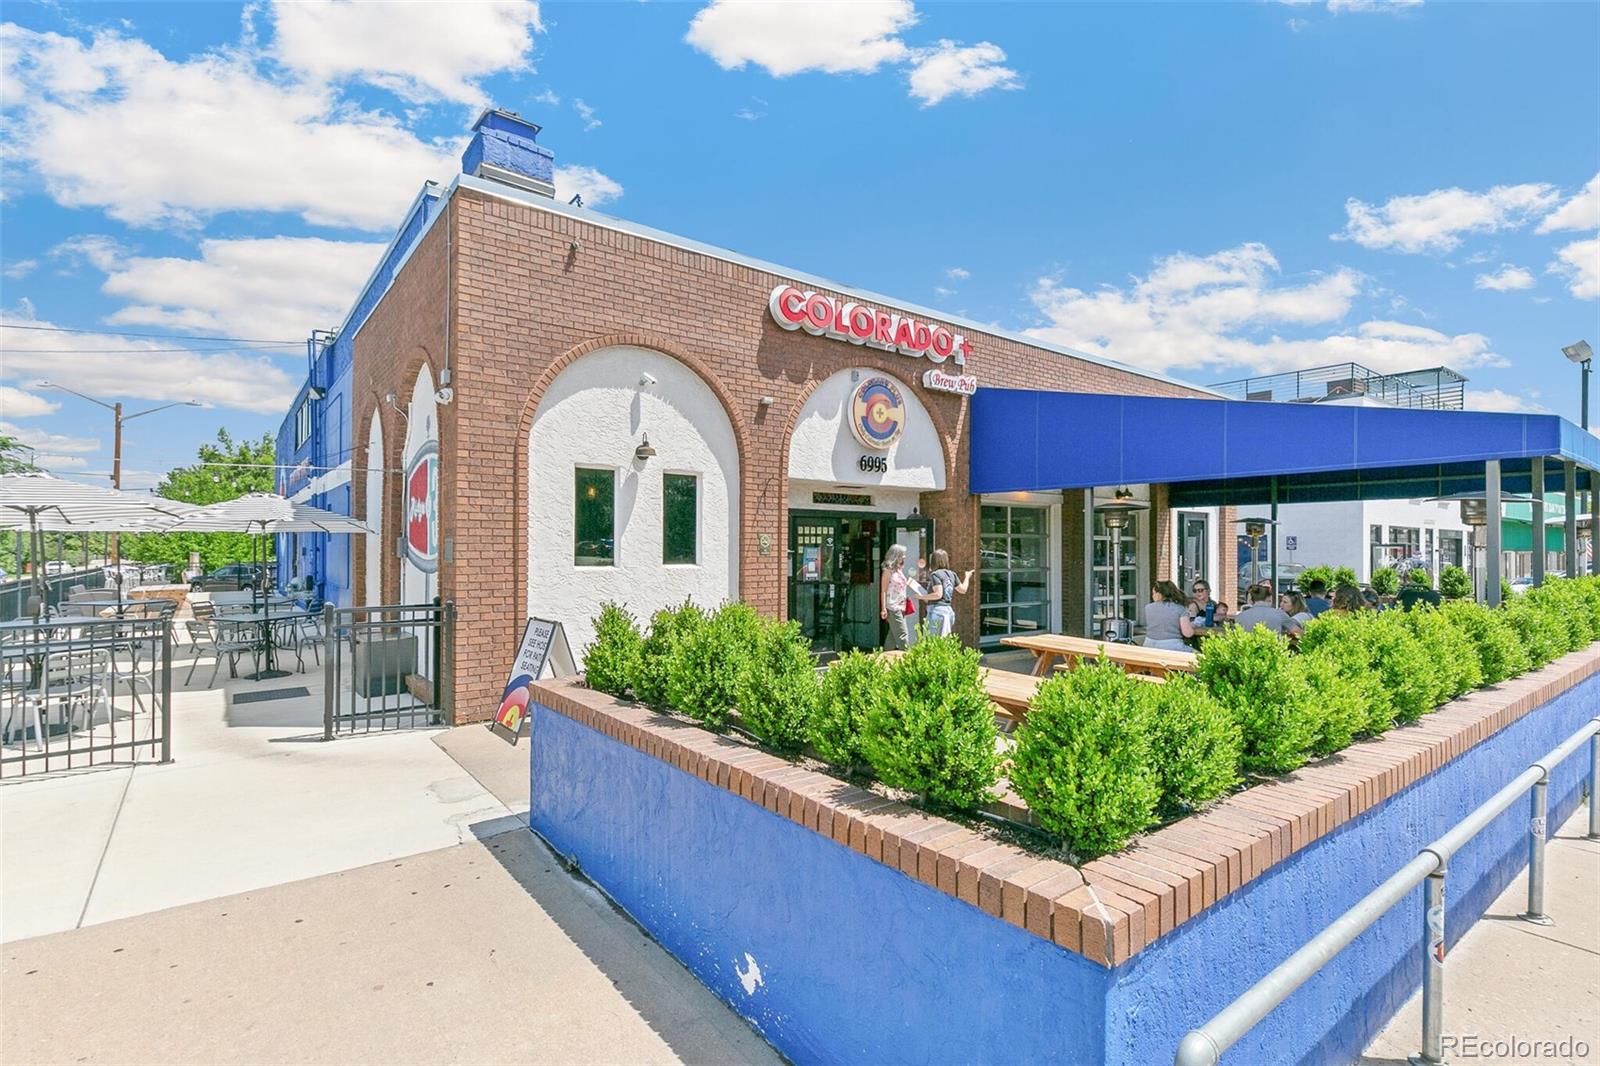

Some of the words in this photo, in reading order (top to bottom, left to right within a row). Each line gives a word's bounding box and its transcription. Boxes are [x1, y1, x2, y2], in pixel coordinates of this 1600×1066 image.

[932, 373, 956, 389] Brew
[957, 378, 975, 392] Pub
[860, 455, 888, 473] 6995
[534, 626, 550, 639] PLEASE
[528, 638, 537, 648] SEE
[536, 640, 548, 651] HOS
[523, 648, 533, 660] FOR
